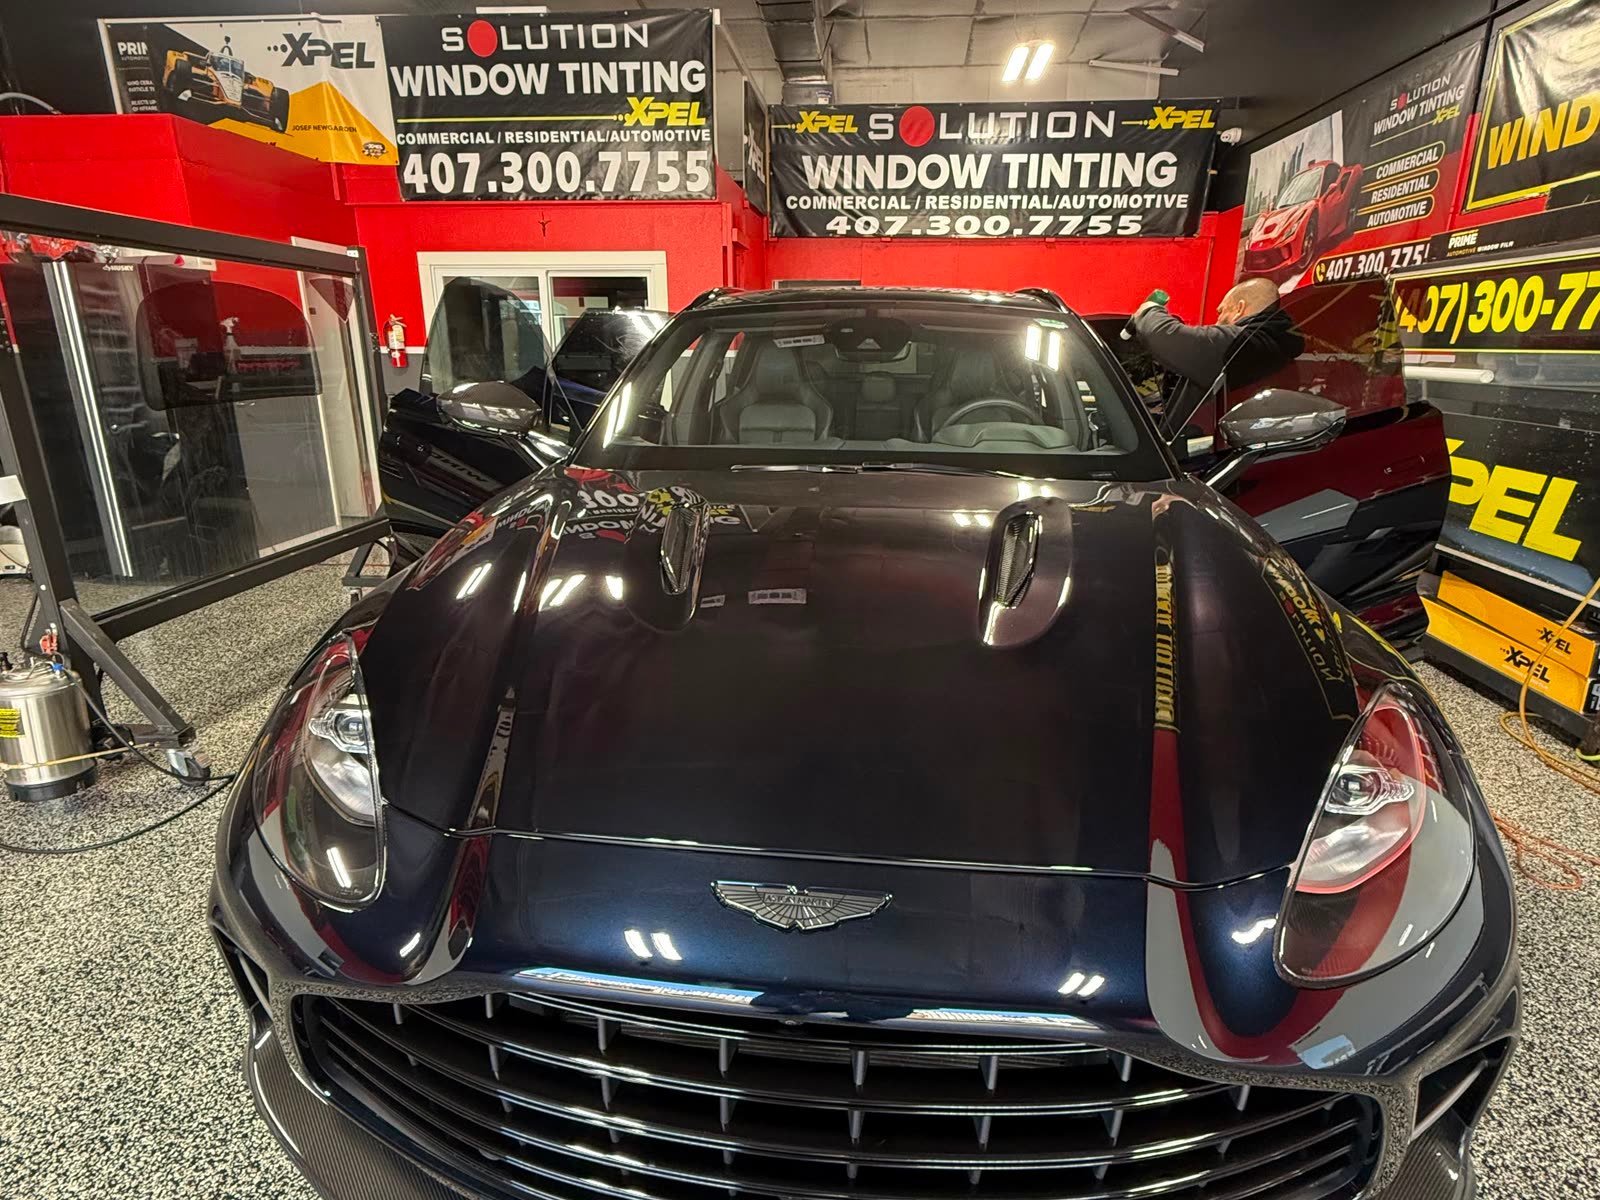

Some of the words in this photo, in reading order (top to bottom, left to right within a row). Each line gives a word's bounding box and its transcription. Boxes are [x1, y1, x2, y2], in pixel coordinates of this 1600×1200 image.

[281, 32, 375, 69] XPEL
[390, 63, 549, 97] WINDOW
[558, 60, 706, 94] TINTING
[624, 96, 706, 127] XPEL
[795, 110, 858, 134] XPEL
[1147, 106, 1216, 130] XPEL
[1374, 104, 1418, 136] WINDOW
[1419, 84, 1465, 117] TINTING
[1432, 104, 1461, 125] XPEL
[313, 124, 357, 133] NEWGARDEN
[397, 132, 494, 145] COMMERCIAL
[1488, 91, 1600, 170] WIND
[403, 151, 710, 193] 407.300.7755
[802, 153, 991, 189] WINDOW
[1002, 151, 1178, 188] TINTING
[1376, 147, 1438, 180] COMMERCIAL
[786, 195, 912, 211] COMMERCIAL
[1371, 177, 1430, 204] RESIDENTIAL
[825, 215, 1143, 236] 407.300.7755
[1367, 201, 1428, 228] AUTOMOTIVE
[1448, 233, 1479, 249] PRIME
[1326, 243, 1430, 281] 407.300.775
[1446, 438, 1582, 561] PEL
[766, 894, 795, 904] ASTON
[797, 898, 833, 908] MARTIN
